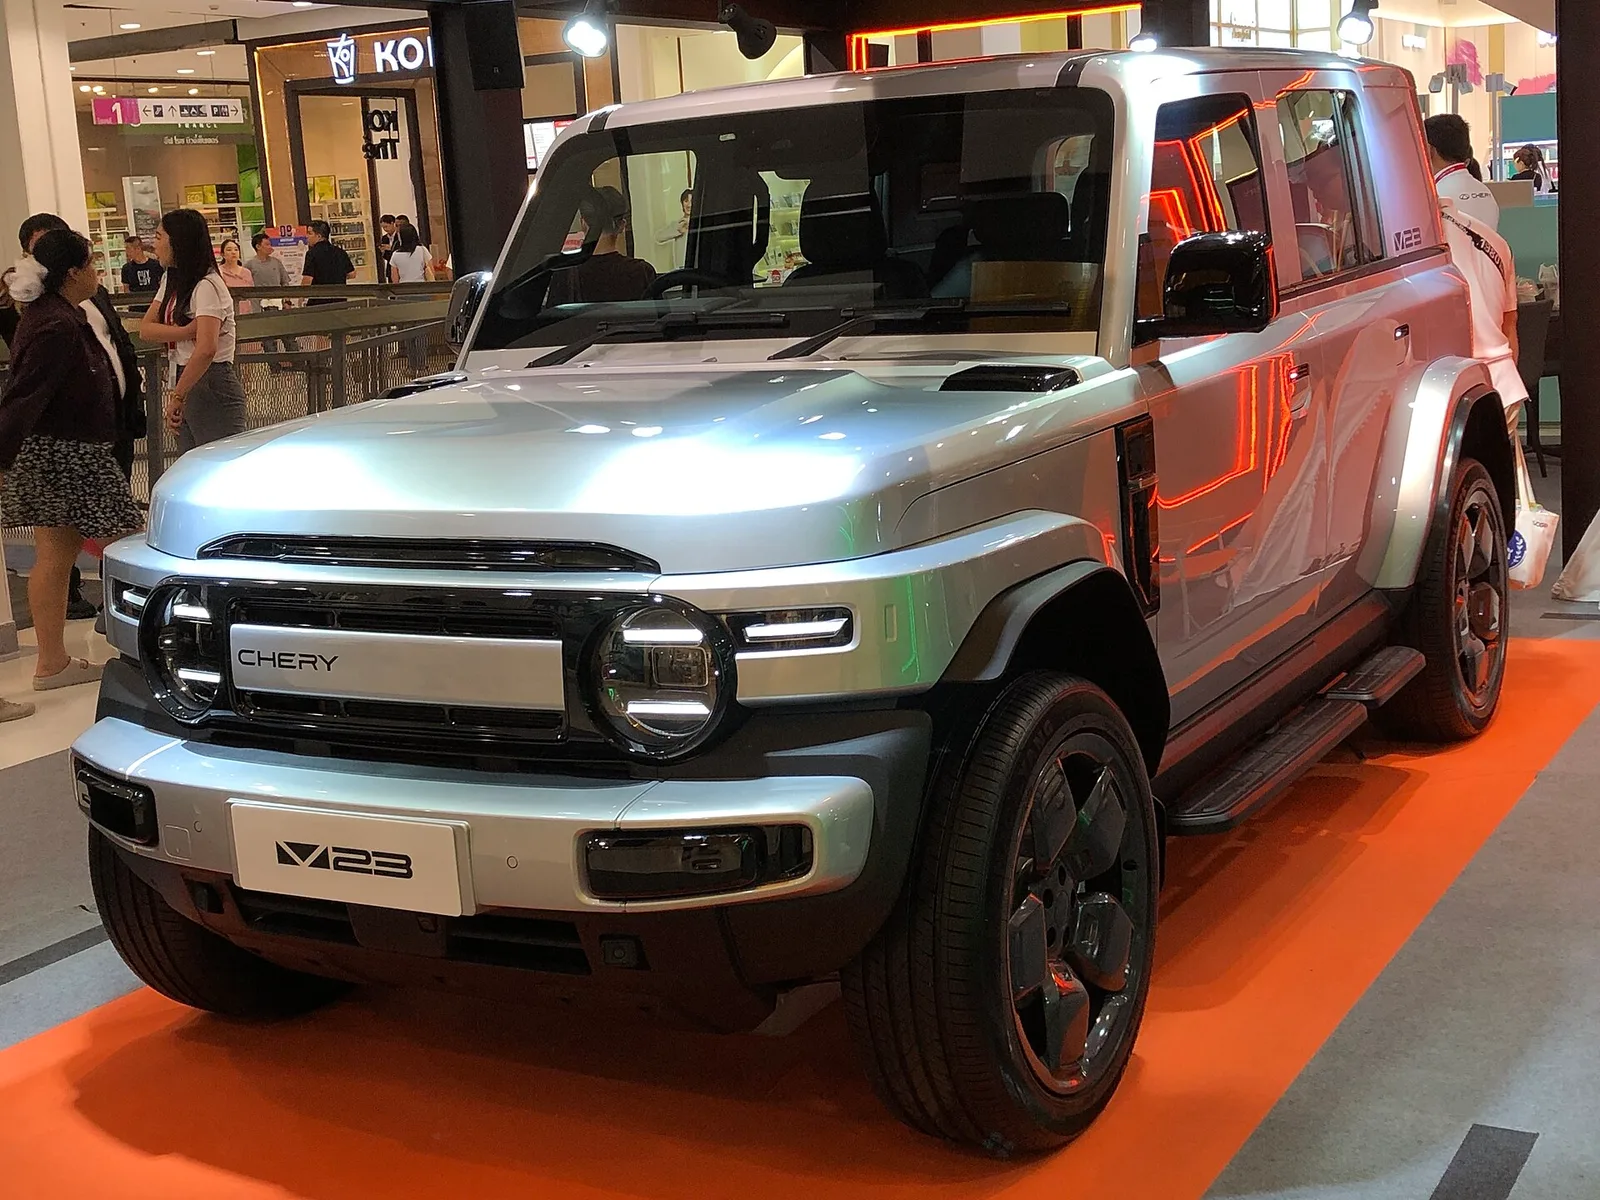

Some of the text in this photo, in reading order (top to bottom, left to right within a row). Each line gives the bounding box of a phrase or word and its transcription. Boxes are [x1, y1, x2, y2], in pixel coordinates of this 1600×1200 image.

[111, 102, 123, 124] 1
[238, 649, 339, 672] CHERY
[275, 840, 413, 879] V23
